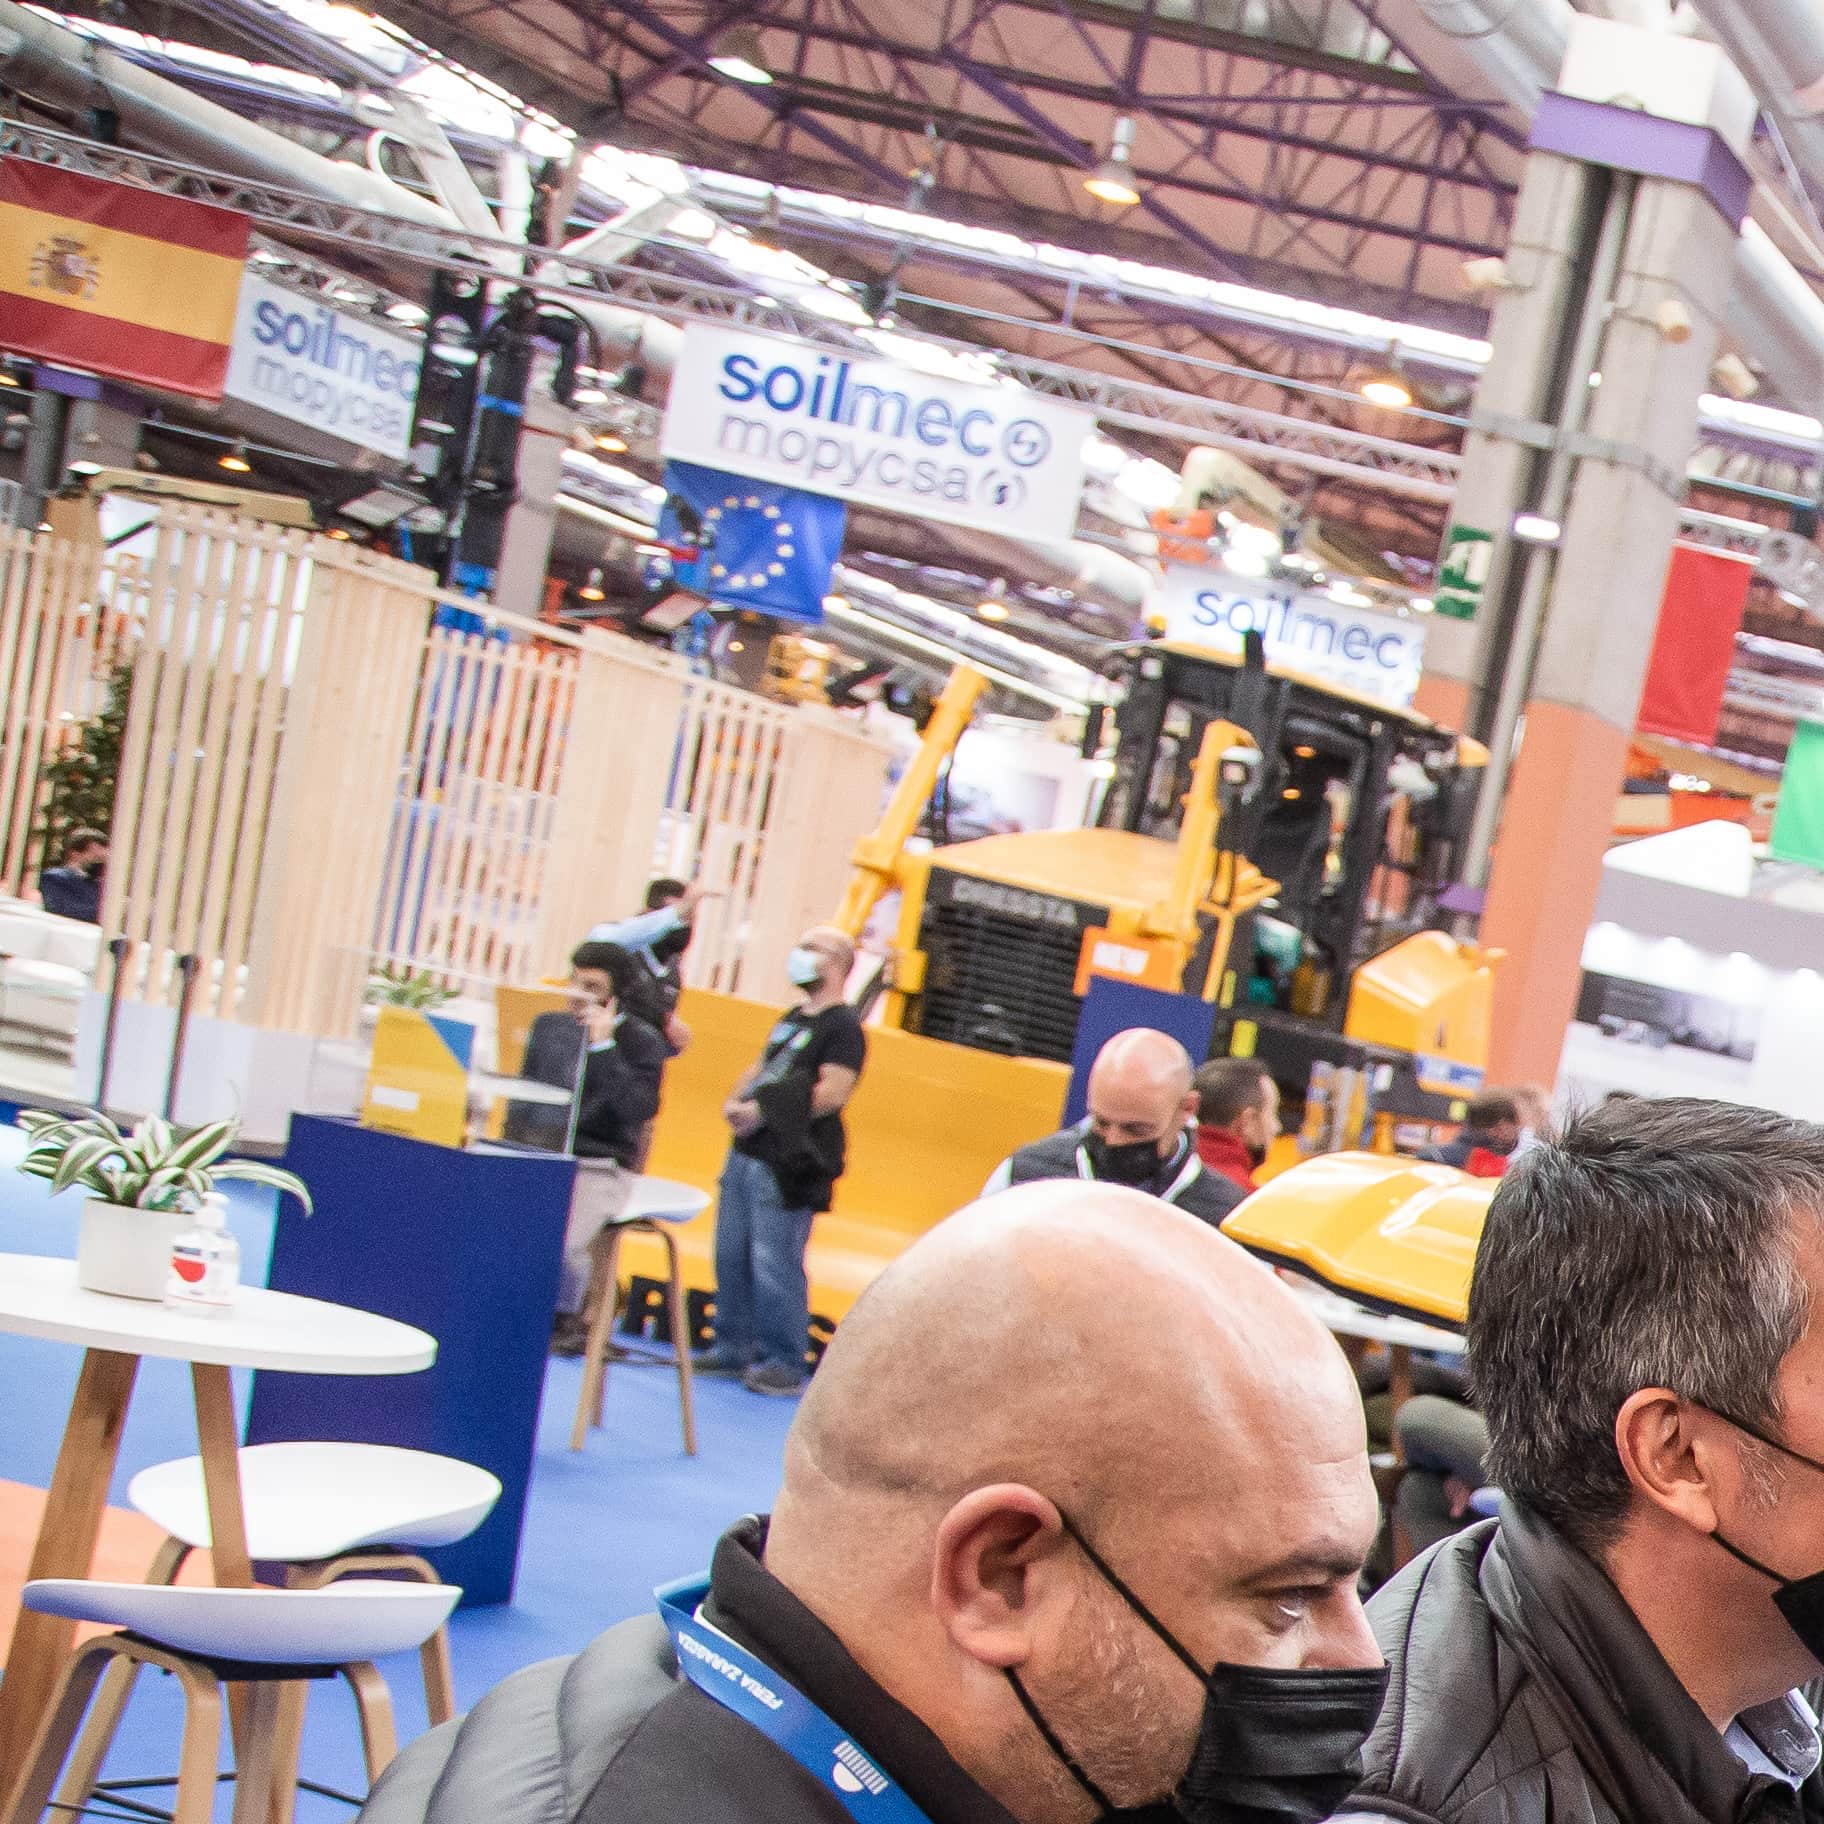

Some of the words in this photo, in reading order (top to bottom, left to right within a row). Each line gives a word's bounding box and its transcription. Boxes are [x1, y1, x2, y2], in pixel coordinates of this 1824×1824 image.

[254, 300, 421, 400] soilmec
[718, 353, 995, 457] soilmec
[718, 412, 973, 501] mopycsa
[1193, 590, 1407, 669] soilmec
